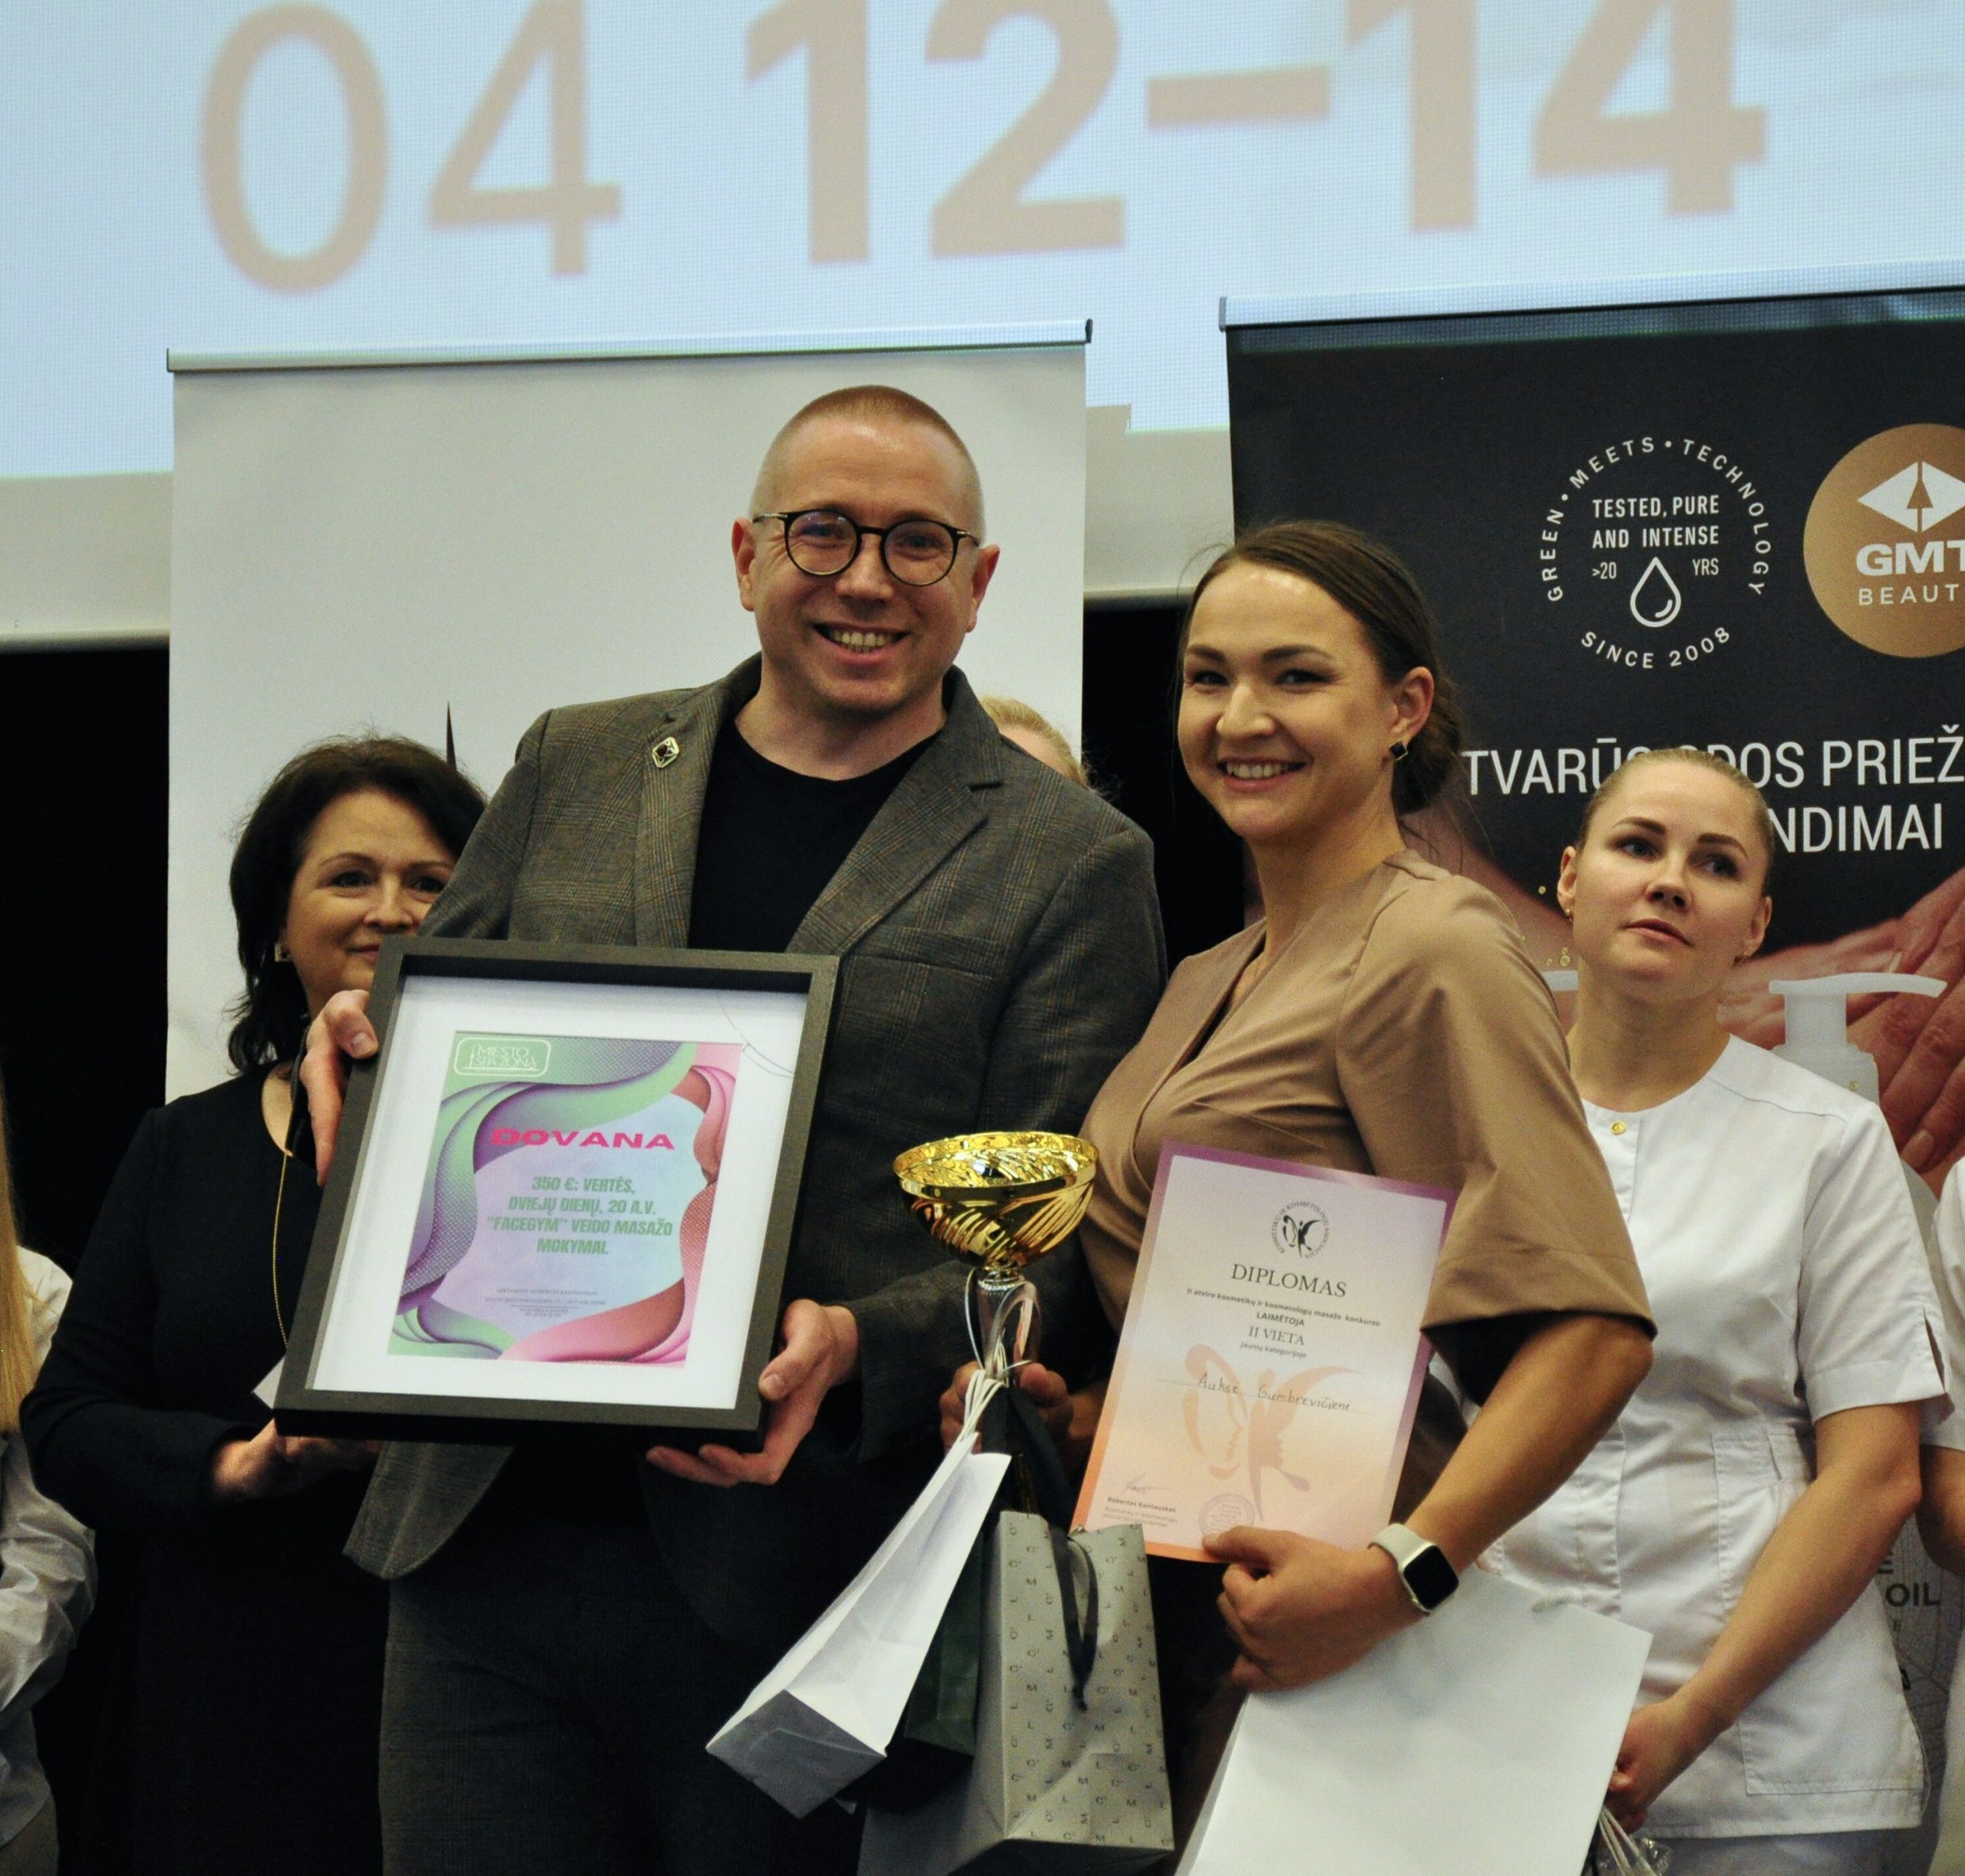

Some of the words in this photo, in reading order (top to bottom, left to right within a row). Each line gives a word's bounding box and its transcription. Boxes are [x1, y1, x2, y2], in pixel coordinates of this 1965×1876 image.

[198, 0, 623, 296] 04
[1592, 497, 1667, 519] TESTED,
[1673, 494, 1719, 516] PURE
[1541, 508, 1564, 602] GREEN
[1569, 437, 1655, 490] MEETS
[1683, 438, 1772, 596] TECHNOLOGY
[1592, 528, 1630, 549] AND
[1643, 525, 1719, 547] INTENSE
[1592, 561, 1617, 580] >20
[1692, 557, 1719, 576] YRS
[1858, 583, 1960, 606] BEAUT
[1581, 631, 1653, 669] SINCE
[1669, 626, 1731, 667] 2008
[1461, 738, 1651, 796] TVARŪ
[1822, 724, 1965, 787] PRIEŽ
[490, 1128, 675, 1150] DOVANA
[532, 1176, 561, 1191] 350
[608, 1199, 627, 1214] 20
[629, 1201, 656, 1215] A.V.
[571, 1219, 610, 1234] VEIDO
[613, 1218, 673, 1237] MASAŽO
[537, 1238, 609, 1255] MOKYMAI.
[1230, 1263, 1347, 1297] DIPLOMAS
[1256, 1311, 1305, 1326] LAIMĖTOJA
[1345, 1316, 1381, 1327] konkurso
[1249, 1326, 1259, 1338] II
[1263, 1328, 1305, 1346] VIETA
[1885, 1583, 1940, 1607] OIL
